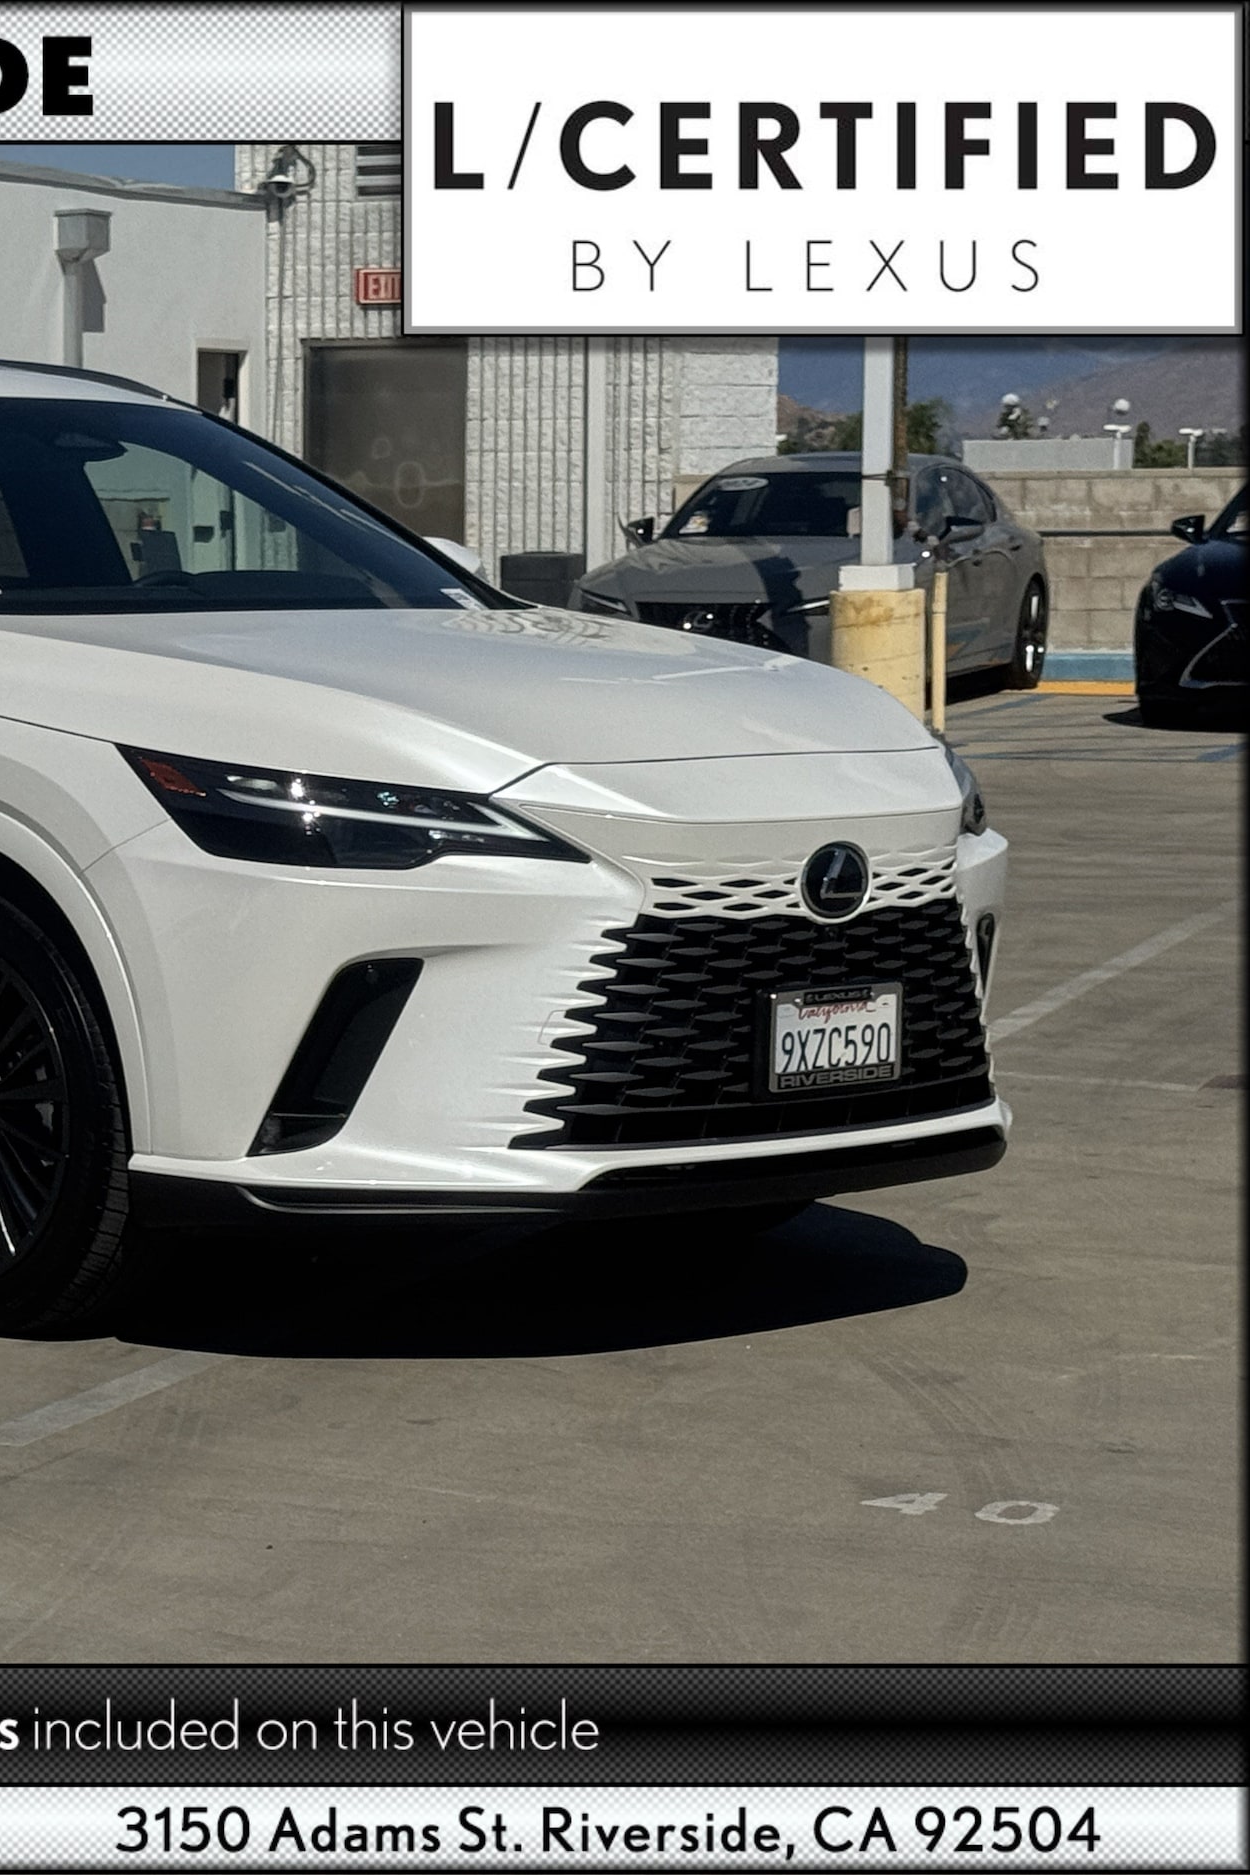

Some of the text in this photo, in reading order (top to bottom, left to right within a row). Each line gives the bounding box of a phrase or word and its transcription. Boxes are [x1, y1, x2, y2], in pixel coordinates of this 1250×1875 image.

[368, 275, 401, 299] EXI
[798, 1001, 877, 1024] California
[782, 1023, 891, 1073] 9XZC590
[780, 1065, 893, 1089] RIVERSIDE
[859, 1492, 1060, 1525] 40
